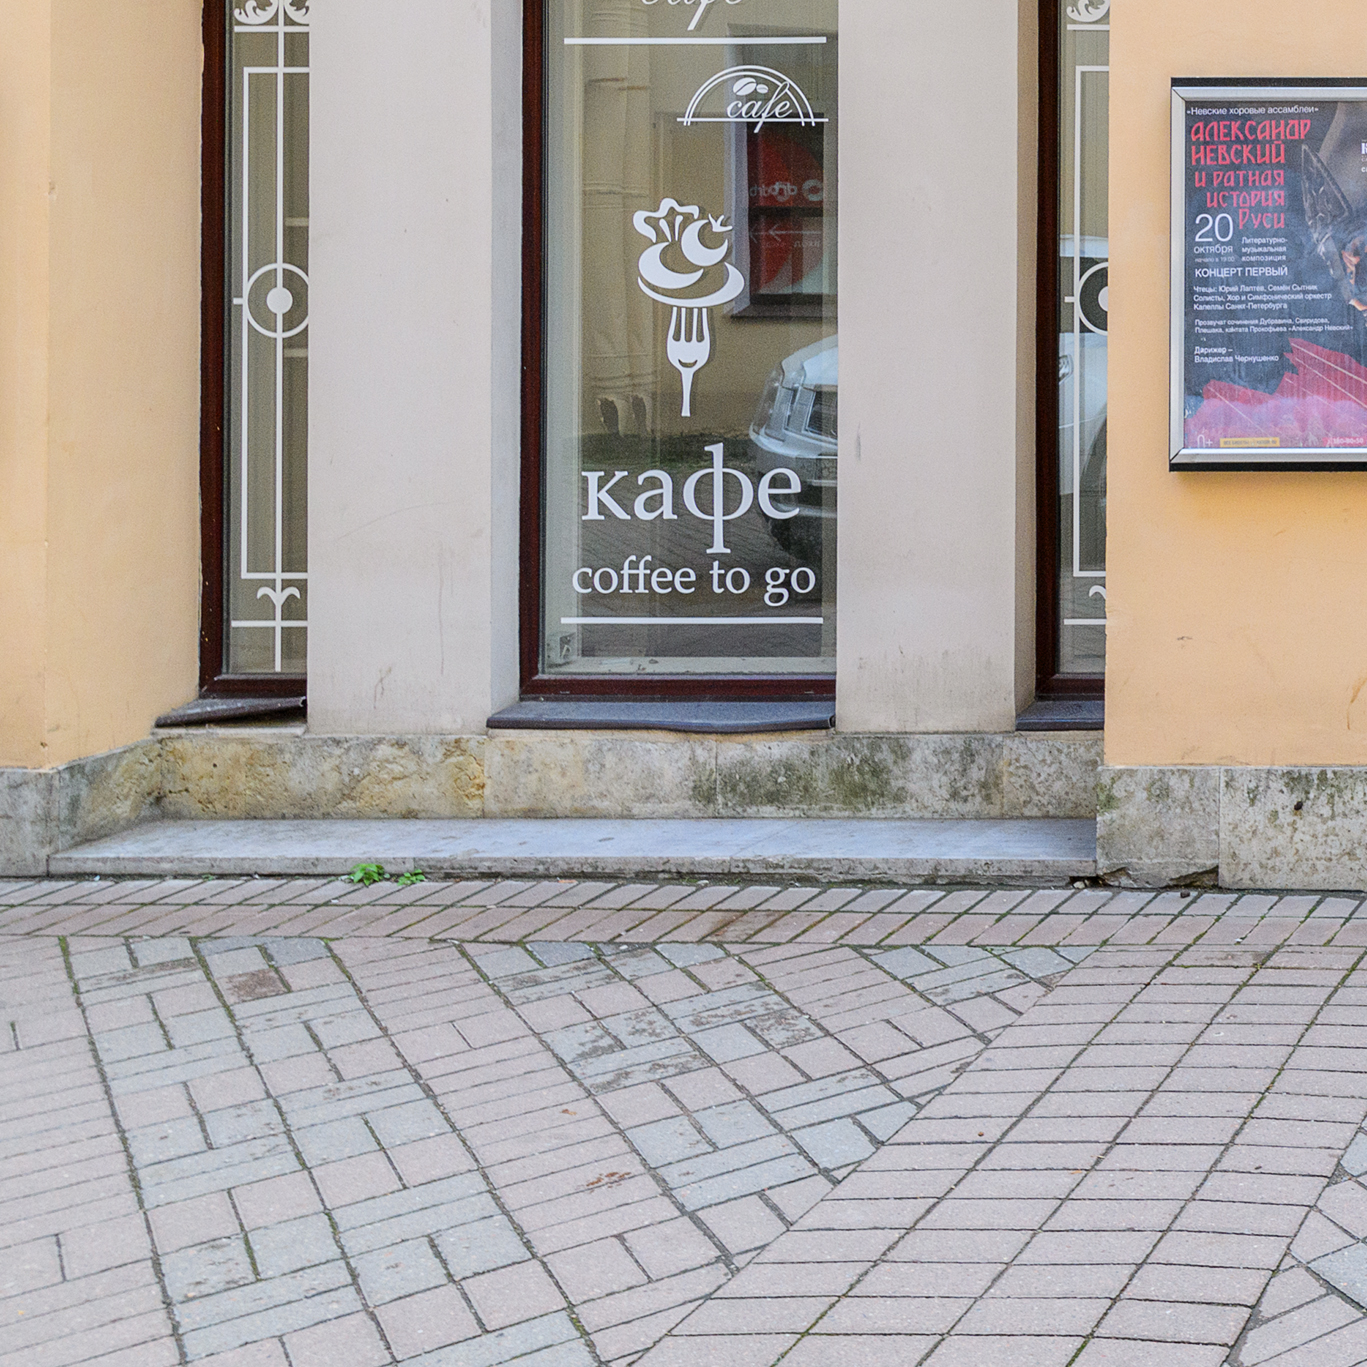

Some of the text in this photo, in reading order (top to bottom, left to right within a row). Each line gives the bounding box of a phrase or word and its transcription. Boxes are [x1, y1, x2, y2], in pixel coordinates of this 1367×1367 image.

[727, 81, 792, 133] cafe
[1187, 105, 1318, 116] «Невские хоровые ассамблеи»
[1191, 120, 1311, 141] АЛЕКСАНДР
[1191, 141, 1285, 165] НЕВСКИЙ
[1195, 213, 1233, 242] 20
[1242, 237, 1288, 245] Литературно-
[1194, 244, 1233, 255] октября
[1242, 246, 1286, 254] музыкальная
[1195, 265, 1288, 278] КОНЦЕРТ ПЕРВЫЙ
[1226, 302, 1287, 311] Санкт-Петербурга
[1194, 354, 1279, 363] Владислав Чернушенко
[581, 443, 801, 554] кафе
[572, 555, 816, 607] coffee to go
